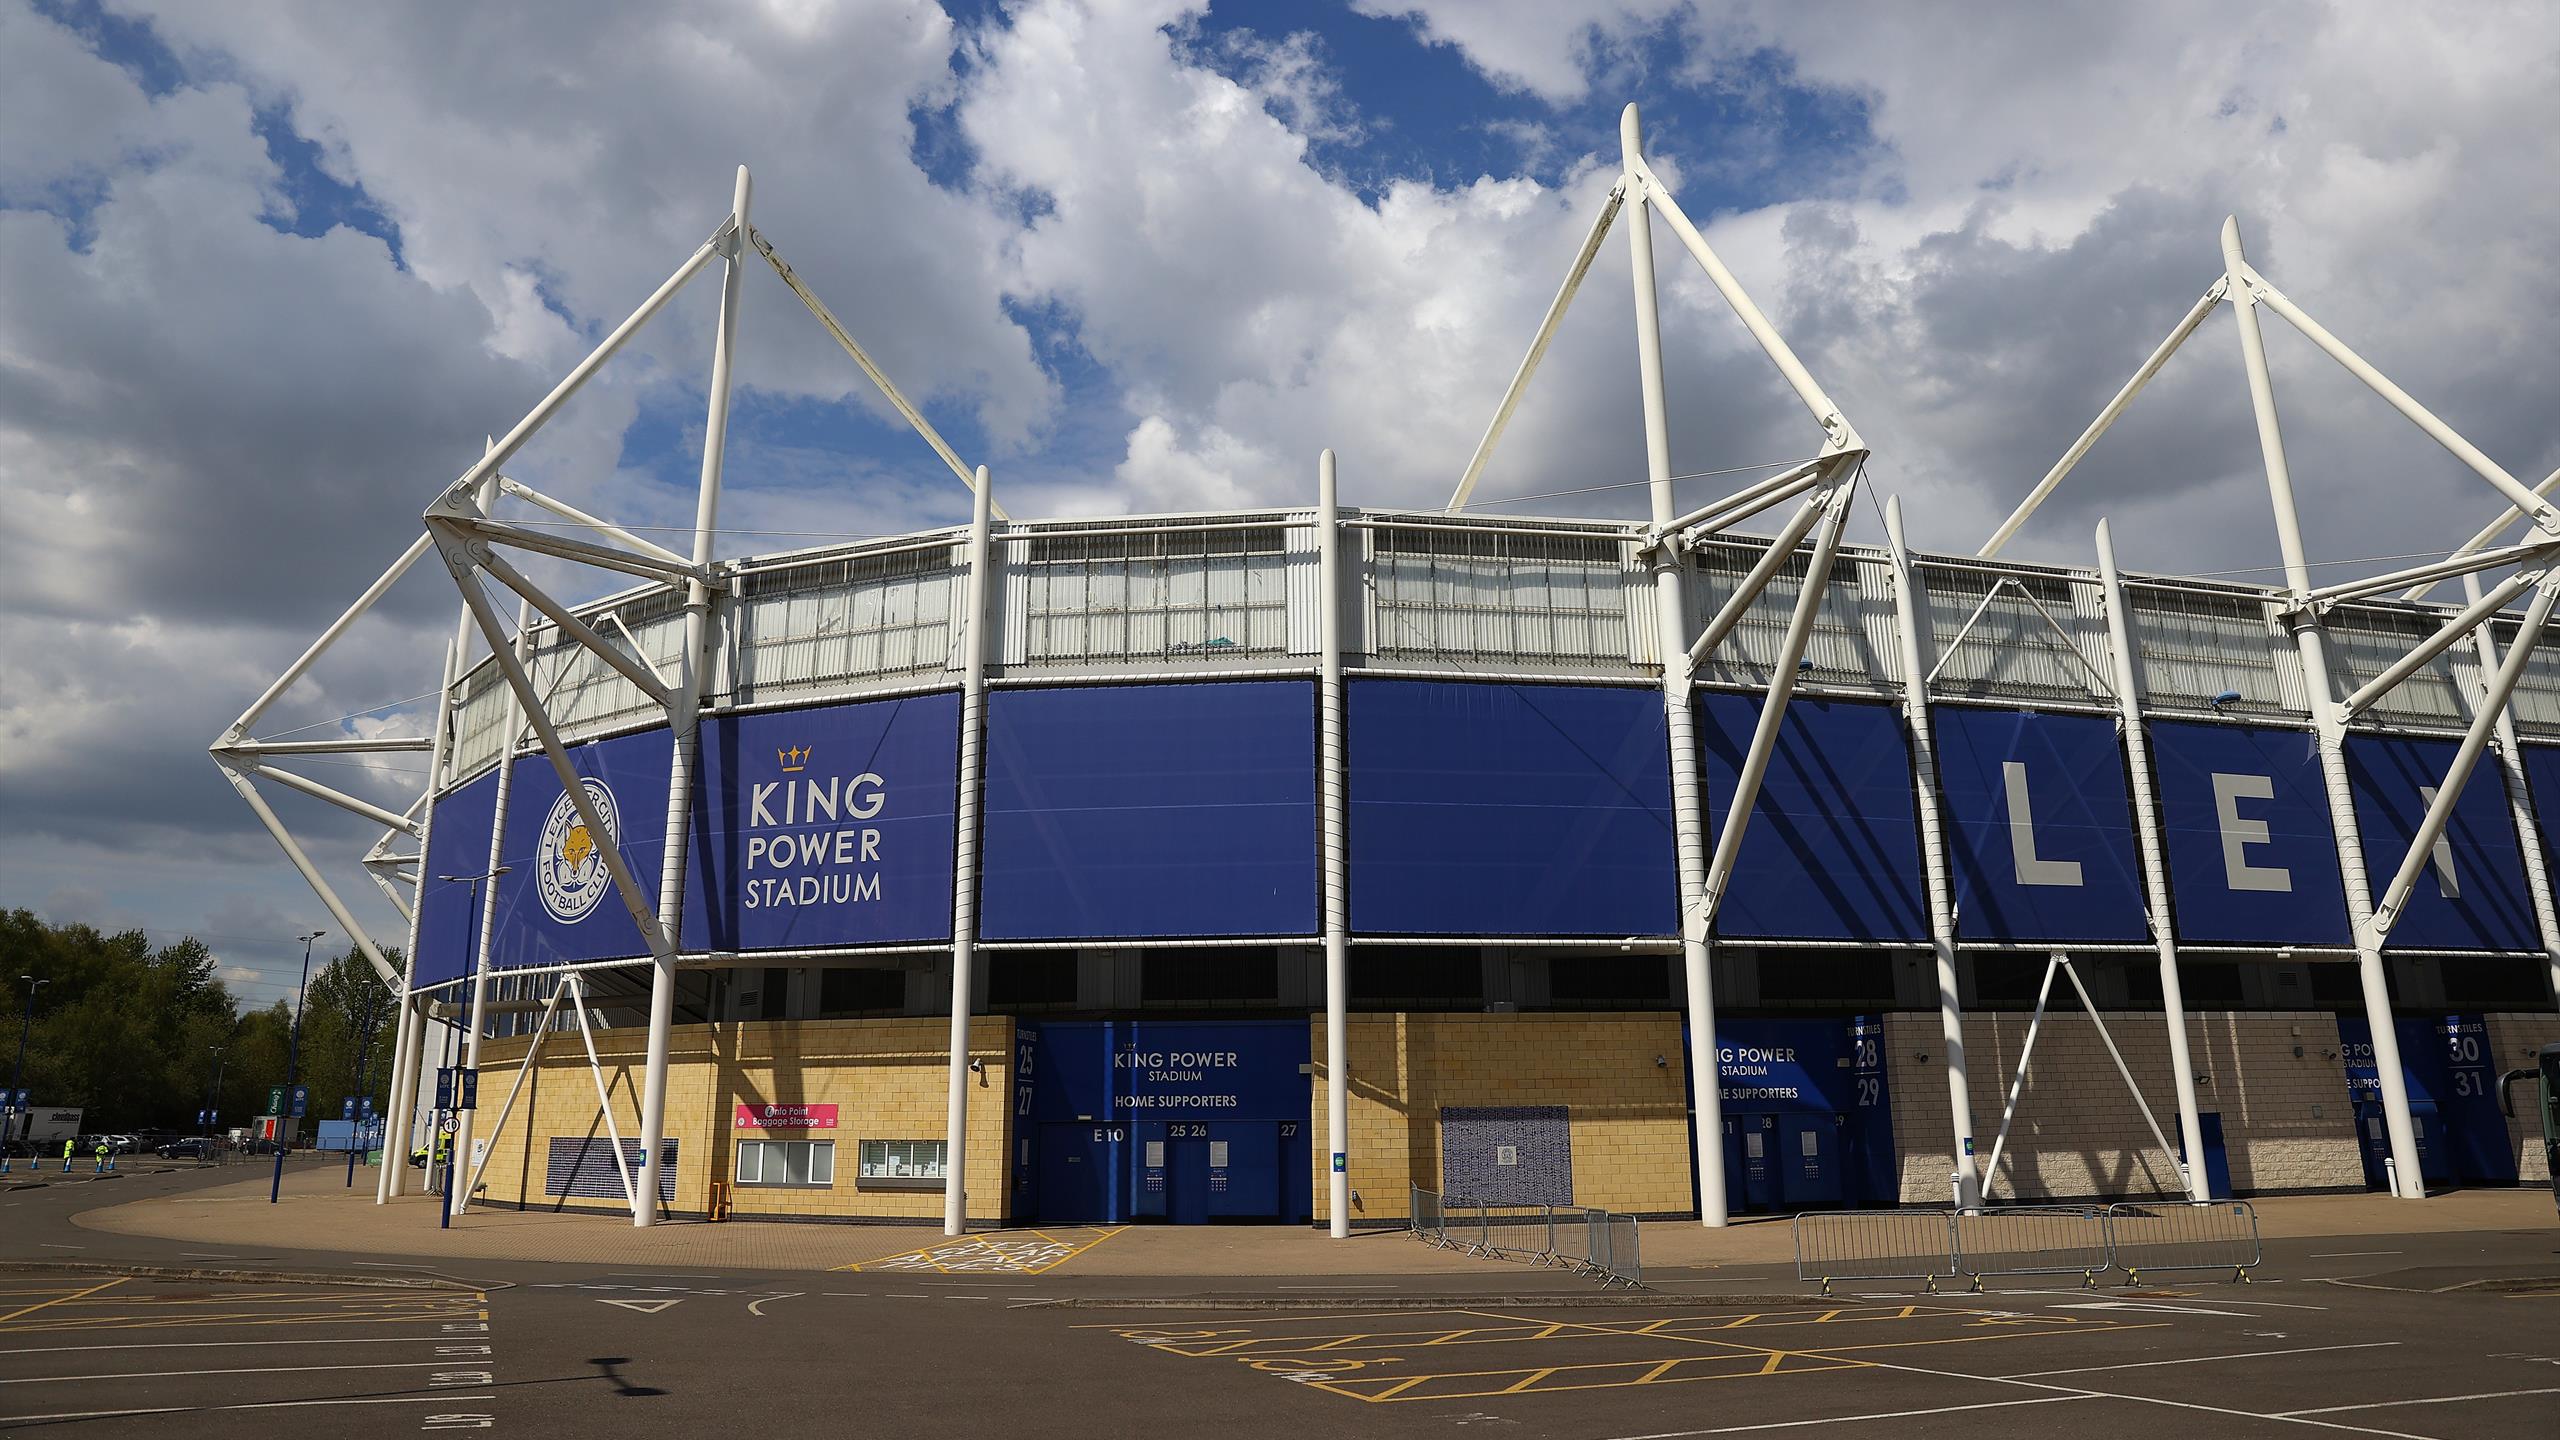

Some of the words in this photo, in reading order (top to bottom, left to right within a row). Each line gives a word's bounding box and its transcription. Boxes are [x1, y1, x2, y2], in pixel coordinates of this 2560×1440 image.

[750, 773, 886, 827] KING
[546, 790, 599, 848] LEICER
[2002, 762, 2083, 886] L
[2211, 773, 2292, 892] E
[747, 828, 881, 870] POWER
[543, 860, 587, 911] FOOTBALL
[587, 860, 607, 899] CLU
[745, 872, 881, 909] STADIUM
[1847, 1024, 1881, 1037] TURNSTILES
[2435, 1023, 2484, 1035] TURNSTILES
[1739, 1048, 1796, 1063] POWER
[1854, 1039, 1878, 1068] 28
[2448, 1036, 2480, 1063] 30
[1020, 1045, 1033, 1075] 25
[1114, 1052, 1164, 1068] KING
[1170, 1052, 1238, 1068] POWER
[1148, 1070, 1203, 1082] STADIUM
[1721, 1065, 1768, 1076] STADIUM
[2352, 1078, 2381, 1089] SUPPO
[2454, 1071, 2484, 1097] 31
[1732, 1087, 1799, 1100] SUPPORTERS
[1858, 1078, 1880, 1107] 29
[1018, 1086, 1033, 1116] 27
[1115, 1095, 1155, 1108] HOME
[1158, 1094, 1238, 1108] SUPPORTERS
[789, 1106, 809, 1116] Point
[445, 1119, 457, 1131] 10
[752, 1117, 788, 1127] Baggage
[789, 1117, 819, 1127] Storage
[1094, 1128, 1102, 1142] E
[1107, 1128, 1124, 1142] 10
[1170, 1125, 1187, 1137] 25
[1191, 1125, 1207, 1137] 26
[1281, 1124, 1297, 1137] 27
[931, 1247, 1070, 1256] CLEAR
[966, 1255, 1052, 1264] ALL
